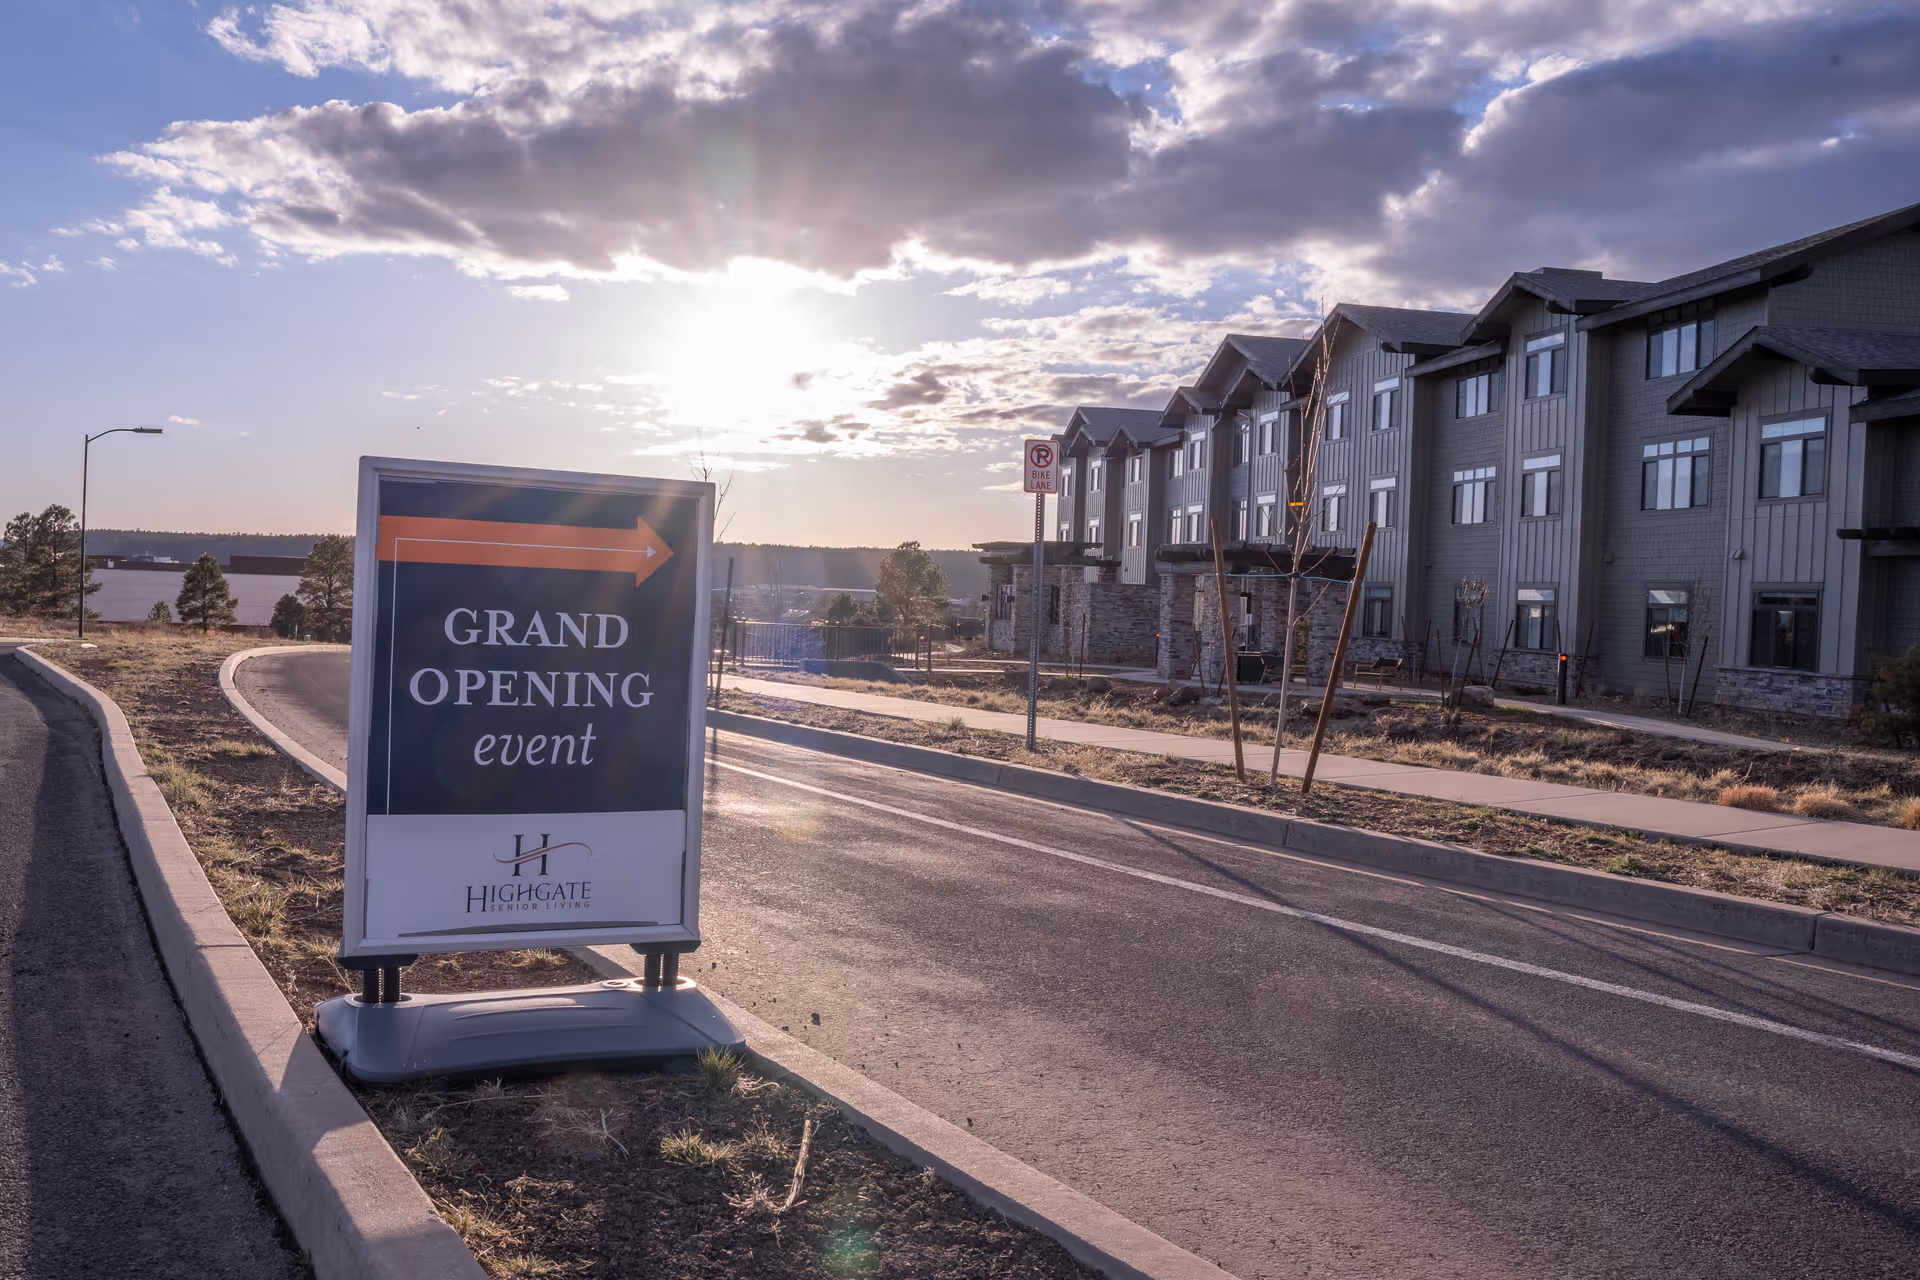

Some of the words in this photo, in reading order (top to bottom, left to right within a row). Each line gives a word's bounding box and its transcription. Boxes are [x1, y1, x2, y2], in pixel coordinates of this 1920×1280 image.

[1037, 448, 1049, 463] P
[1032, 470, 1050, 479] BIKE
[1031, 481, 1051, 490] LANE
[444, 607, 629, 649] GRAND
[409, 667, 655, 708] OPENING
[473, 723, 597, 766] event
[490, 903, 538, 912] SENIOR
[546, 901, 591, 910] LIVING
